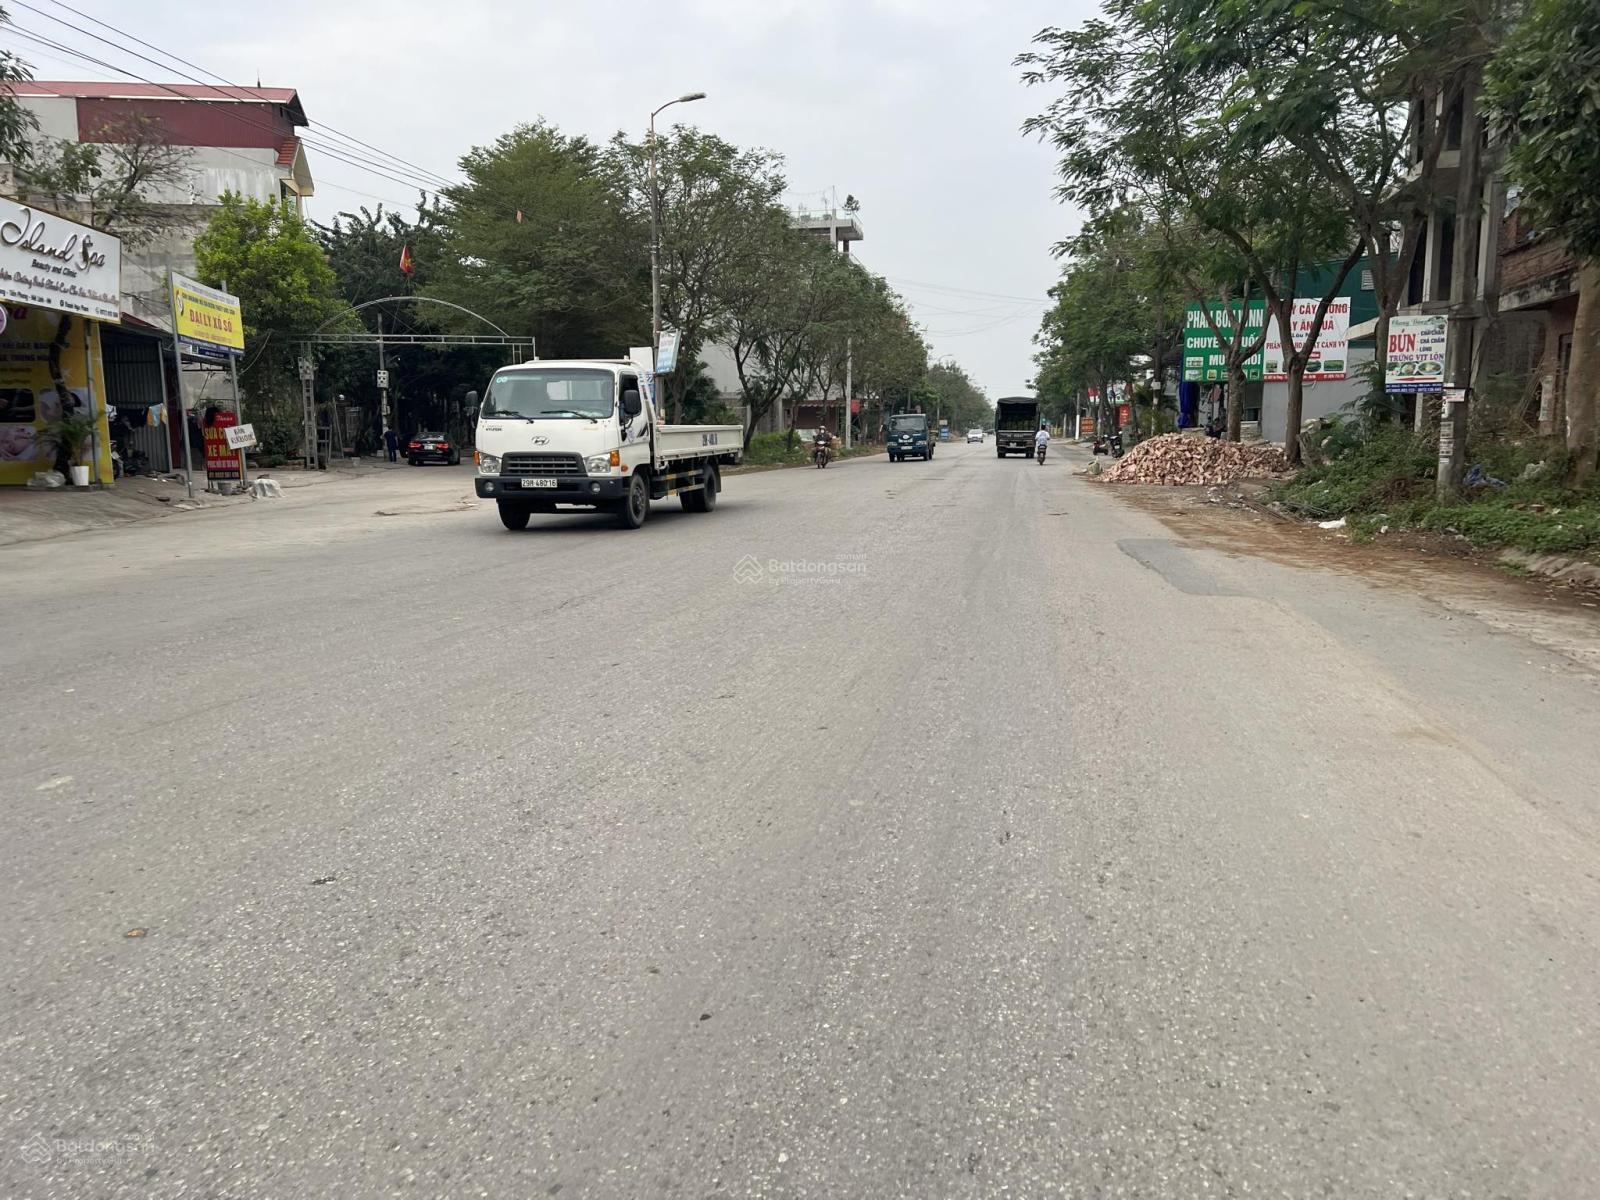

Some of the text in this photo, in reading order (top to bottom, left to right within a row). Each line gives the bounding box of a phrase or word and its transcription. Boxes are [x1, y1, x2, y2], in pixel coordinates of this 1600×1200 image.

[1, 208, 105, 276] Island Spa
[1388, 328, 1416, 353] BÚN
